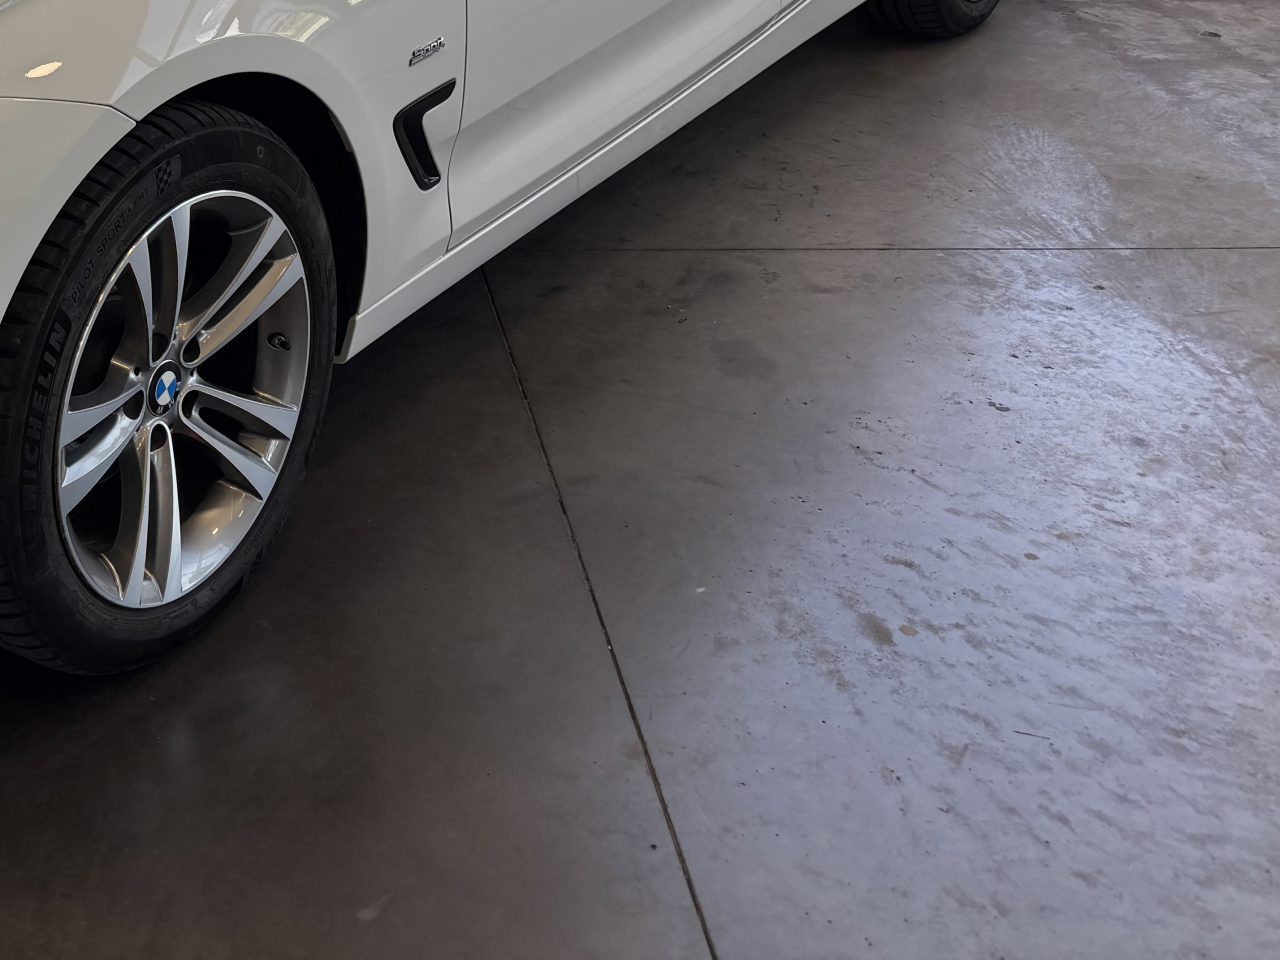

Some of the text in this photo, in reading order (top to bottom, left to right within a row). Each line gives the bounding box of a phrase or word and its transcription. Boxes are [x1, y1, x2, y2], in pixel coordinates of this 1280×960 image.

[71, 258, 97, 304] PILOT
[96, 213, 128, 258] SPORT
[23, 319, 69, 514] MICHELIN
